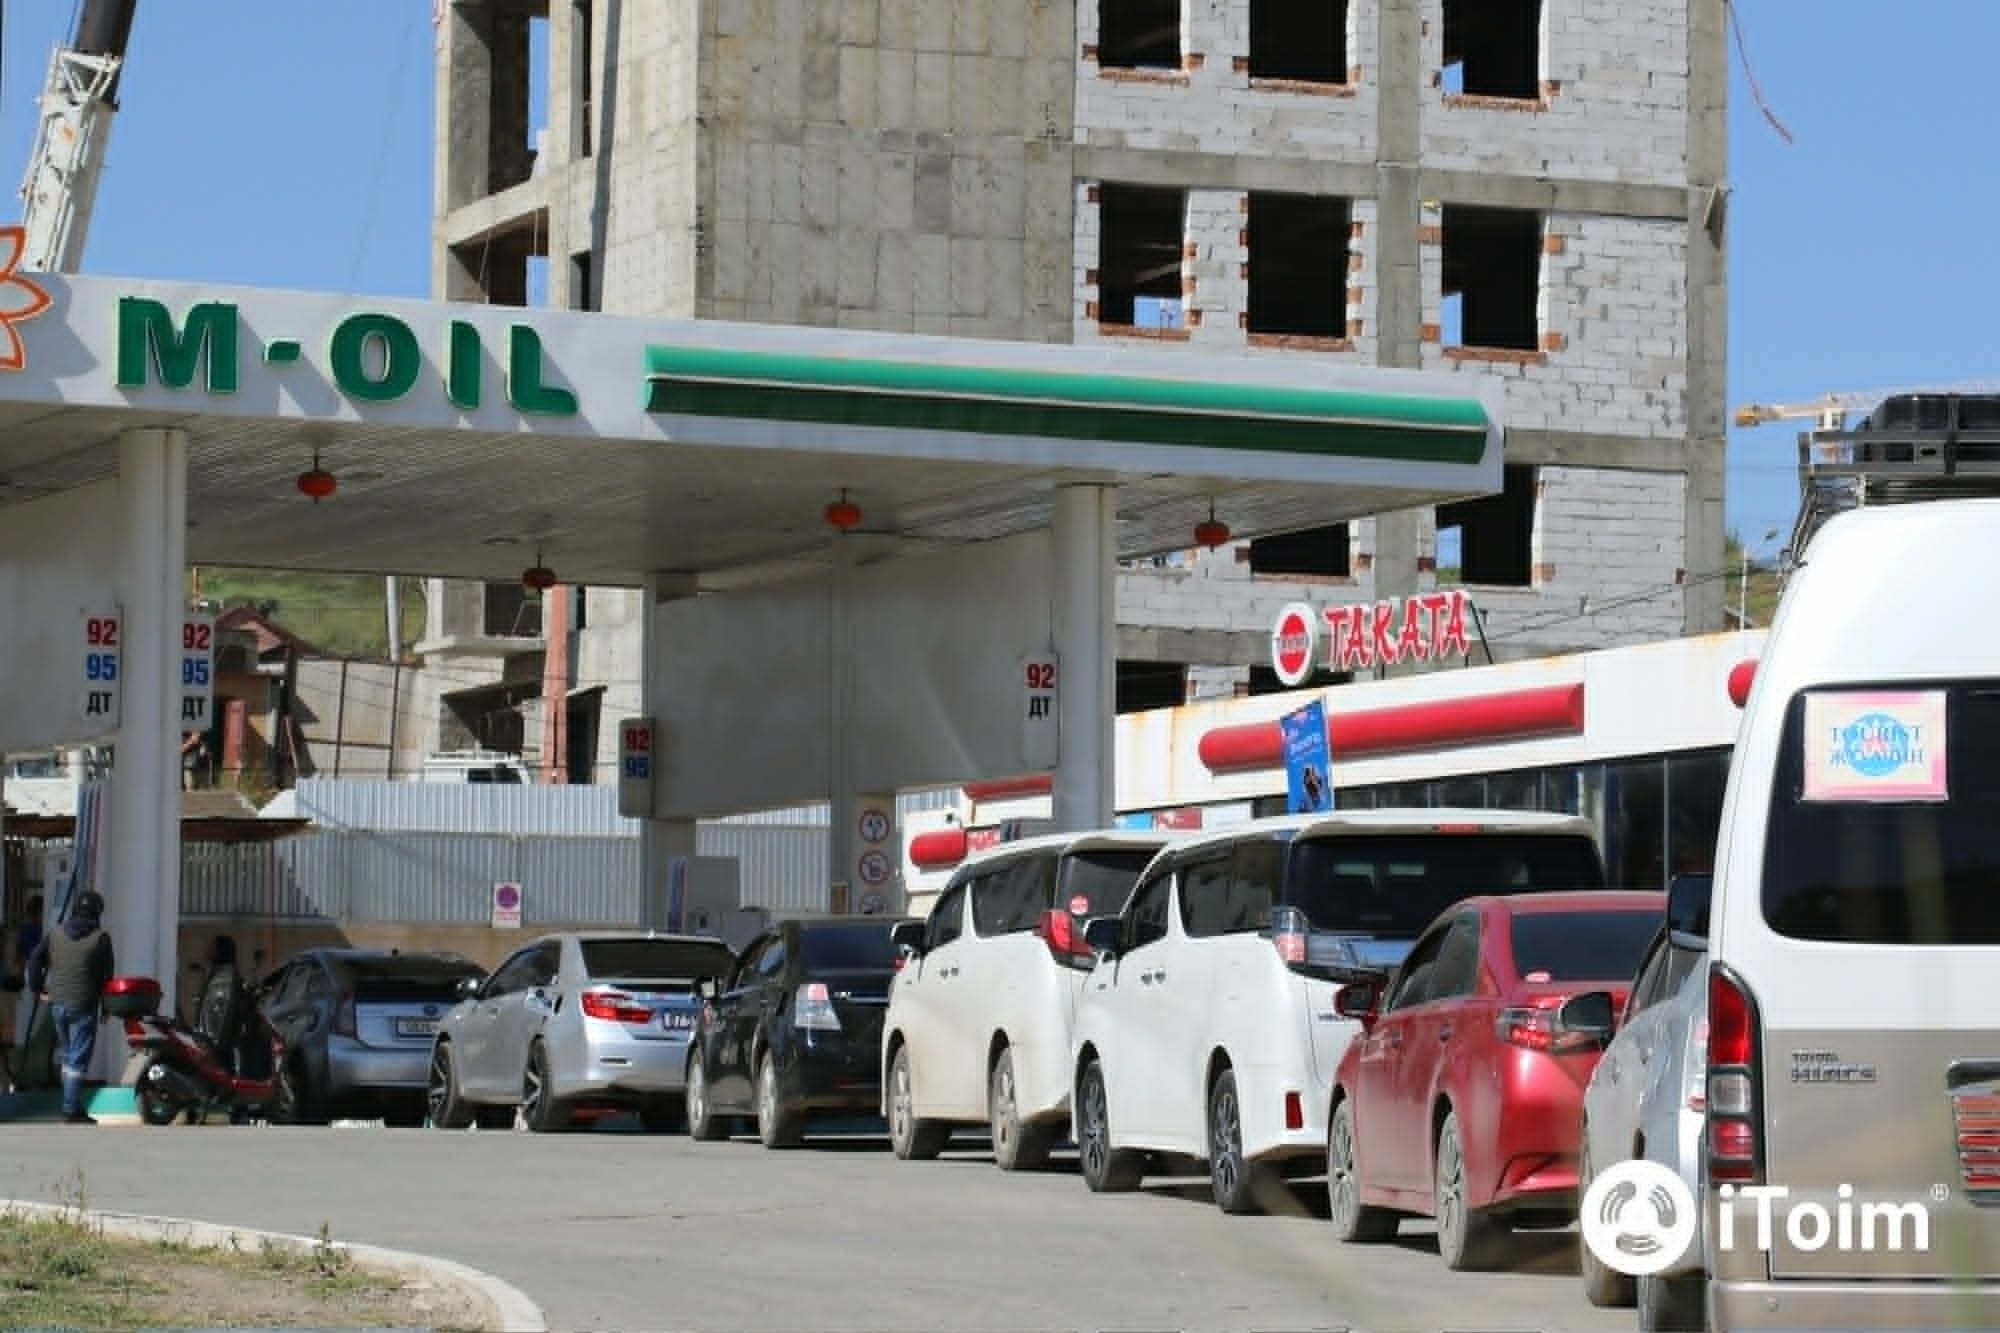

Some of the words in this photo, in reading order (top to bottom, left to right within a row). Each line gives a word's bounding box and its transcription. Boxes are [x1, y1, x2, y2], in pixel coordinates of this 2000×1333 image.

[115, 295, 578, 416] M-OIL
[87, 617, 117, 646] 92
[183, 622, 211, 650] 92
[1324, 590, 1470, 674] TAKATA
[87, 654, 117, 681] 95
[183, 657, 210, 686] 95
[1026, 662, 1055, 689] 92
[87, 691, 113, 715] ДТ
[182, 696, 206, 720] ДТ
[1028, 695, 1051, 721] ДТ
[625, 728, 649, 751] 92
[1829, 726, 1923, 743] TOURIST
[625, 756, 649, 778] 95
